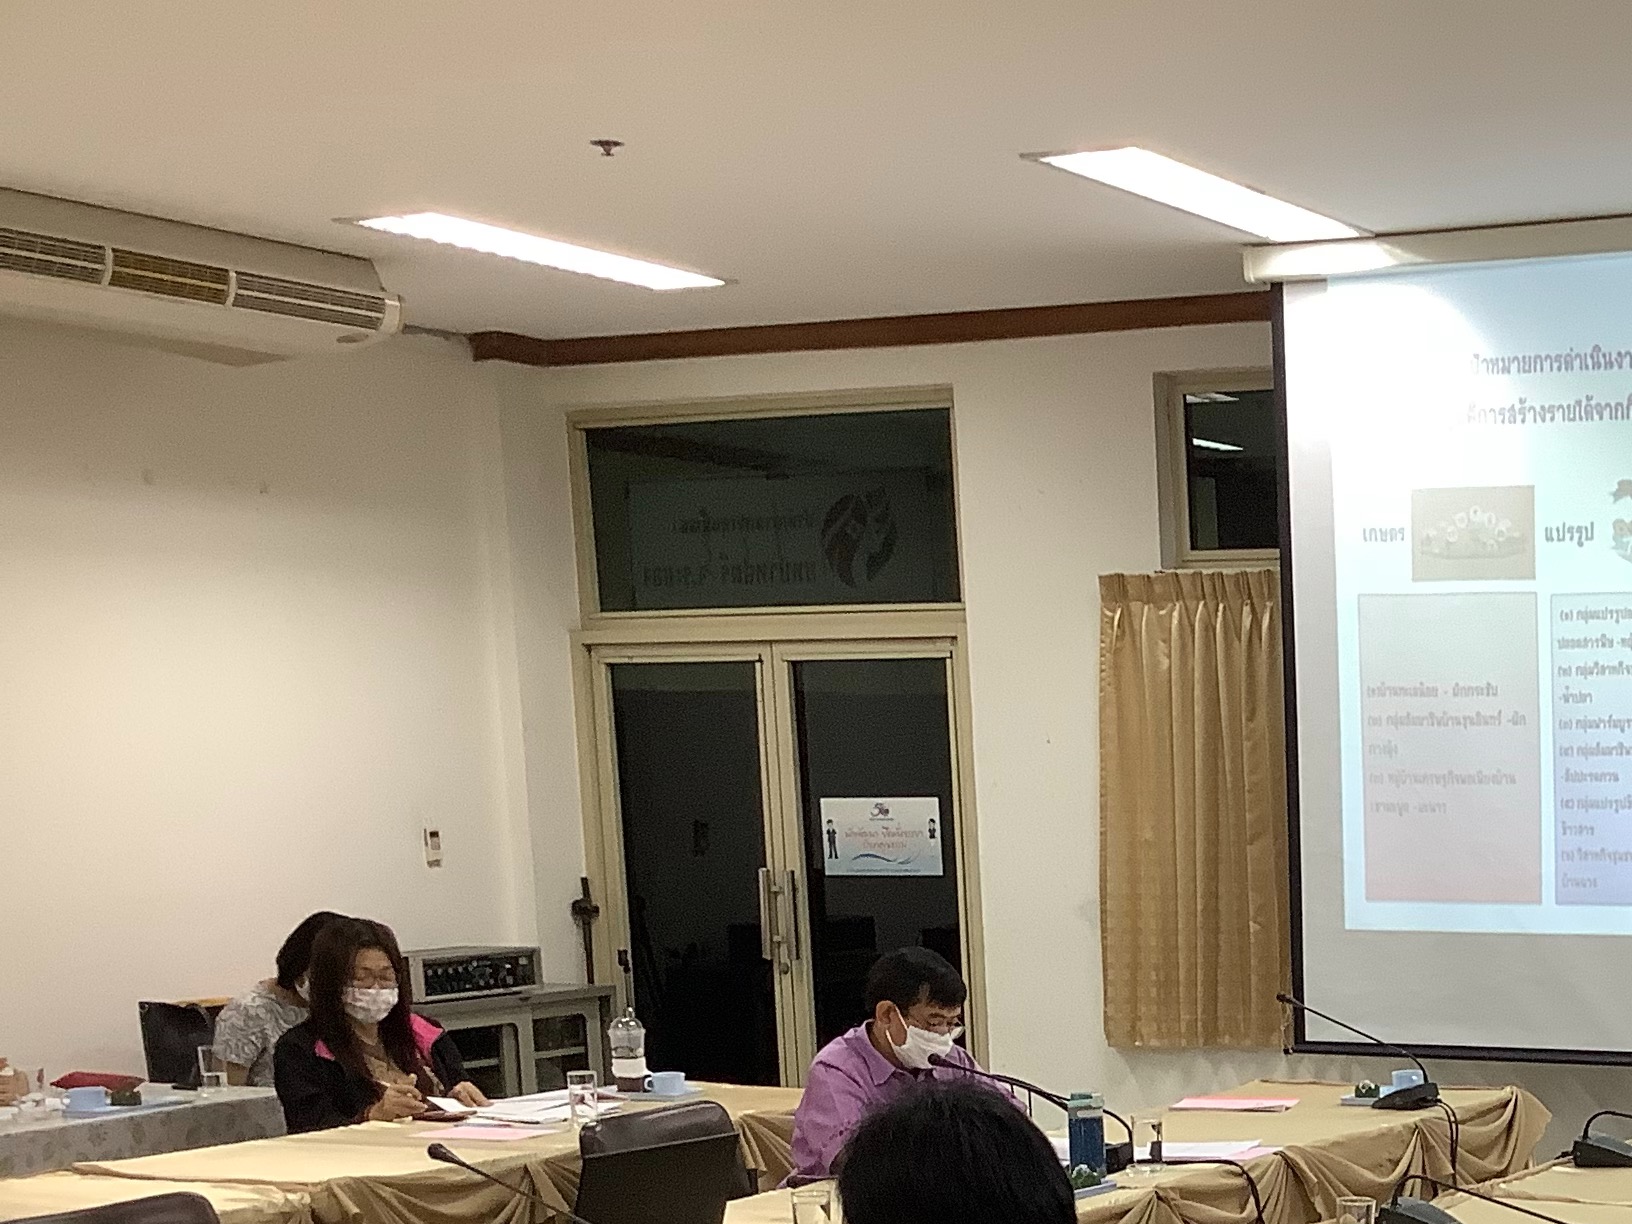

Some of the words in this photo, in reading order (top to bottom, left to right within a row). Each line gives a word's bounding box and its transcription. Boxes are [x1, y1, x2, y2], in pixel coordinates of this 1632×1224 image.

[1362, 526, 1405, 543] เกษตร
[1544, 521, 1595, 548] แปรรูป
